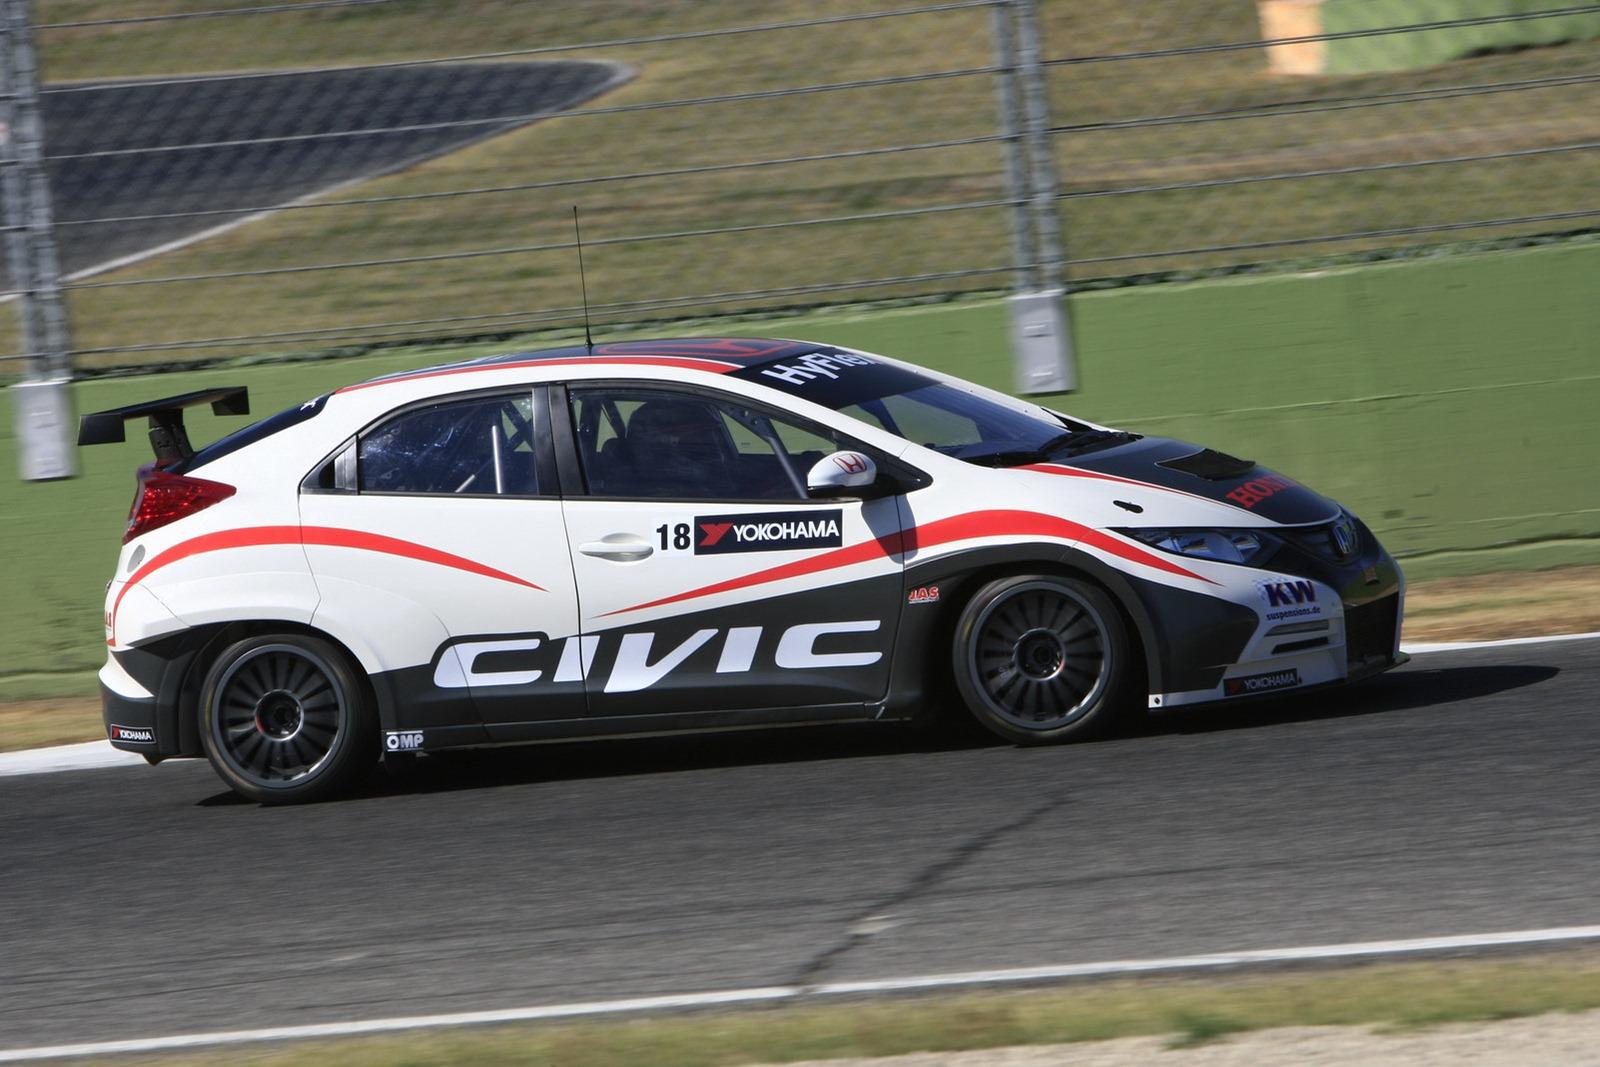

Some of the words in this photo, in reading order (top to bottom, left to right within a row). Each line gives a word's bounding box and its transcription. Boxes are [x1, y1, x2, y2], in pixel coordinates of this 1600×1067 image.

[656, 523, 690, 550] 18
[733, 520, 839, 542] YOKOHAMA
[908, 586, 939, 600] JAS
[1264, 580, 1316, 607] KW
[1266, 606, 1321, 620] suspensions.de
[433, 620, 883, 693] CIVIC
[386, 734, 424, 749] OMP
